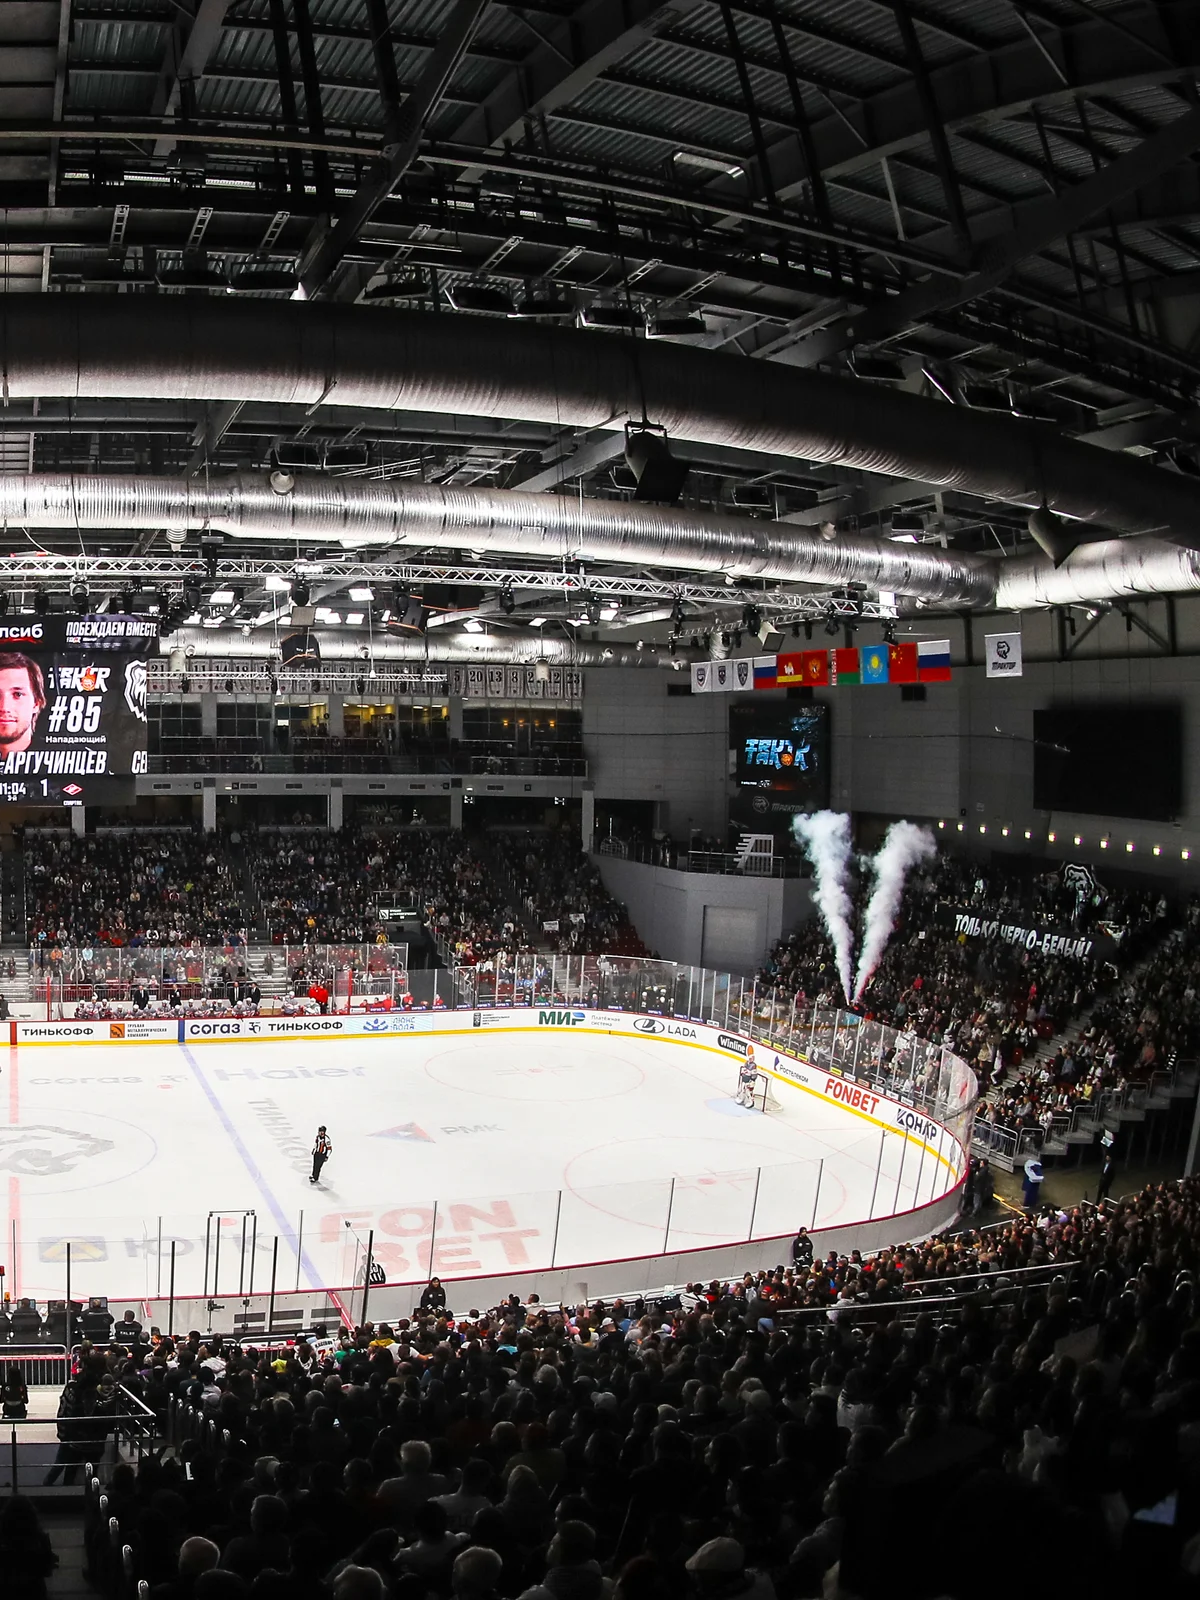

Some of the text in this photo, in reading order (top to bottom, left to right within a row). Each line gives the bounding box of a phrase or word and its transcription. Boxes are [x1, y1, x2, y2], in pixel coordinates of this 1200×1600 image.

[66, 621, 157, 638] ПОБЕЖДАЕМ ВМЕСТЕ
[49, 695, 102, 733] #85
[46, 735, 107, 744] Нападающий
[40, 779, 48, 797] 1
[538, 1011, 586, 1026] МИР
[22, 1027, 94, 1036] ТИНЬКОФФ
[268, 1021, 343, 1032] ТИНЬКОФФ
[667, 1024, 697, 1039] LADA
[720, 1036, 746, 1053] Winline
[213, 1067, 365, 1080] Haier
[825, 1078, 880, 1115] FONBET
[440, 1124, 505, 1135] РМК
[320, 1201, 517, 1242] FON
